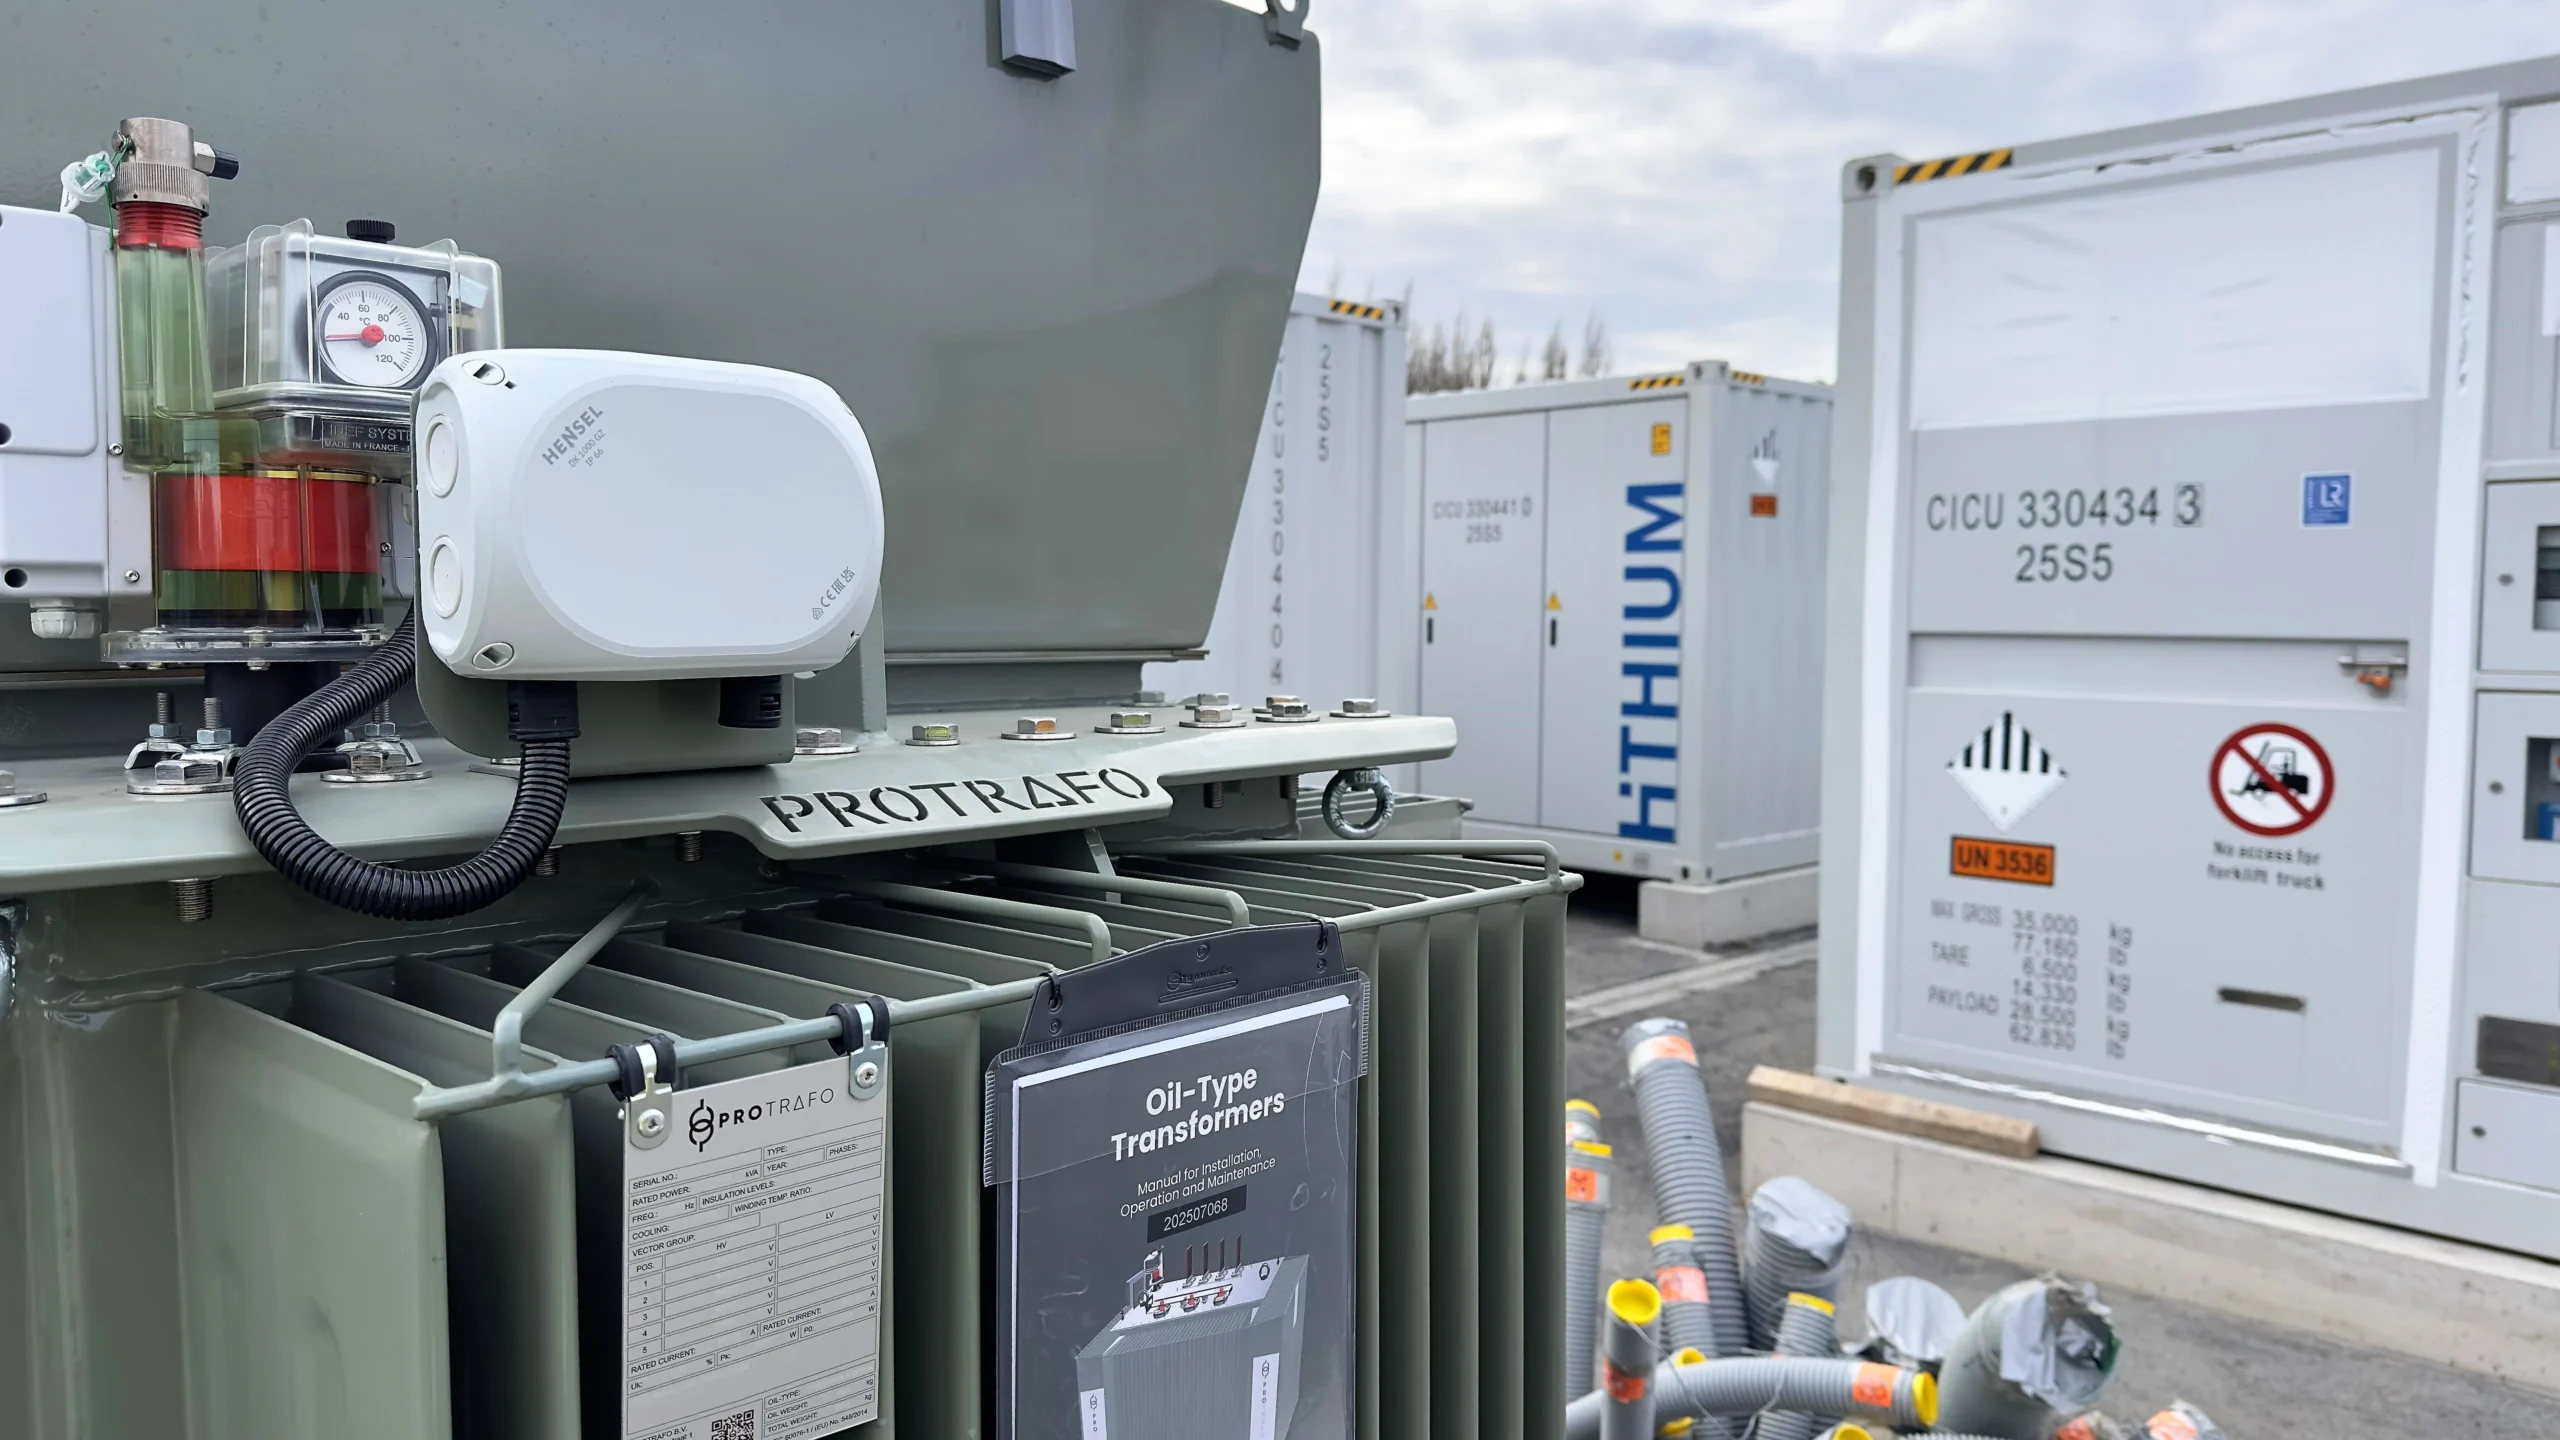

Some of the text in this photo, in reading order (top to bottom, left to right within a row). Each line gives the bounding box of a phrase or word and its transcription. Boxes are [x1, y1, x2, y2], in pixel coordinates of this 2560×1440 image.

[337, 311, 350, 321] 40
[358, 304, 370, 313] 60
[377, 313, 390, 323] 80
[383, 334, 401, 343] 100
[374, 354, 393, 363] 120
[541, 405, 604, 466] HENSEL
[324, 440, 350, 449] MADE
[352, 442, 362, 450] IN
[363, 442, 399, 452] FRANCE
[568, 454, 581, 468] DK
[579, 438, 596, 458] 1000
[585, 448, 604, 467] IP 66
[1926, 484, 2202, 531] CICU 330434 3
[2015, 543, 2114, 582] 25S5
[759, 767, 1151, 833] PROTRAFO
[1957, 845, 2048, 876] UN 3536
[2238, 845, 2293, 864] access
[2276, 871, 2325, 891] truck
[1145, 1068, 1258, 1116] Oil-Type
[718, 1088, 835, 1128] PROTRAFO
[1110, 1091, 1285, 1162] Transformers
[766, 1145, 788, 1156] TYPE:
[829, 1143, 859, 1156] PHASES:
[745, 1168, 759, 1178] kVA
[766, 1160, 788, 1172] YEAR:
[1137, 1147, 1262, 1196] Manual for Installation,
[632, 1173, 678, 1190] SERIAL NO.:
[1120, 1156, 1276, 1218] Operation and Maintenance
[632, 1186, 691, 1207] RATED POWER:
[701, 1180, 776, 1206] INSULATION LEVELS:
[734, 1198, 767, 1213] WINDING
[791, 1186, 812, 1199] RATIO:
[684, 1202, 695, 1211] Hz
[825, 1211, 835, 1220] LV
[1163, 1198, 1228, 1232] 202507068
[632, 1211, 659, 1223] FREQ.:
[631, 1224, 670, 1241] COOLING:
[631, 1234, 696, 1258] VECTOR GROUP:
[716, 1240, 728, 1250] HV
[636, 1261, 655, 1273] POS.
[762, 1319, 786, 1332] RATED
[787, 1307, 822, 1324] CURRENT:
[630, 1360, 657, 1374] RATED
[657, 1347, 696, 1366] CURRENT:
[720, 1353, 731, 1361] Pk:
[630, 1381, 643, 1391] Uk:
[767, 1389, 801, 1406] OIL-TYPE:
[767, 1401, 809, 1420] OIL WEIGHT:
[814, 1422, 829, 1432] (EU)
[829, 1419, 840, 1427] No.
[841, 1408, 868, 1423] 548/2014
[767, 1411, 818, 1433] TOTAL WEIGHT:
